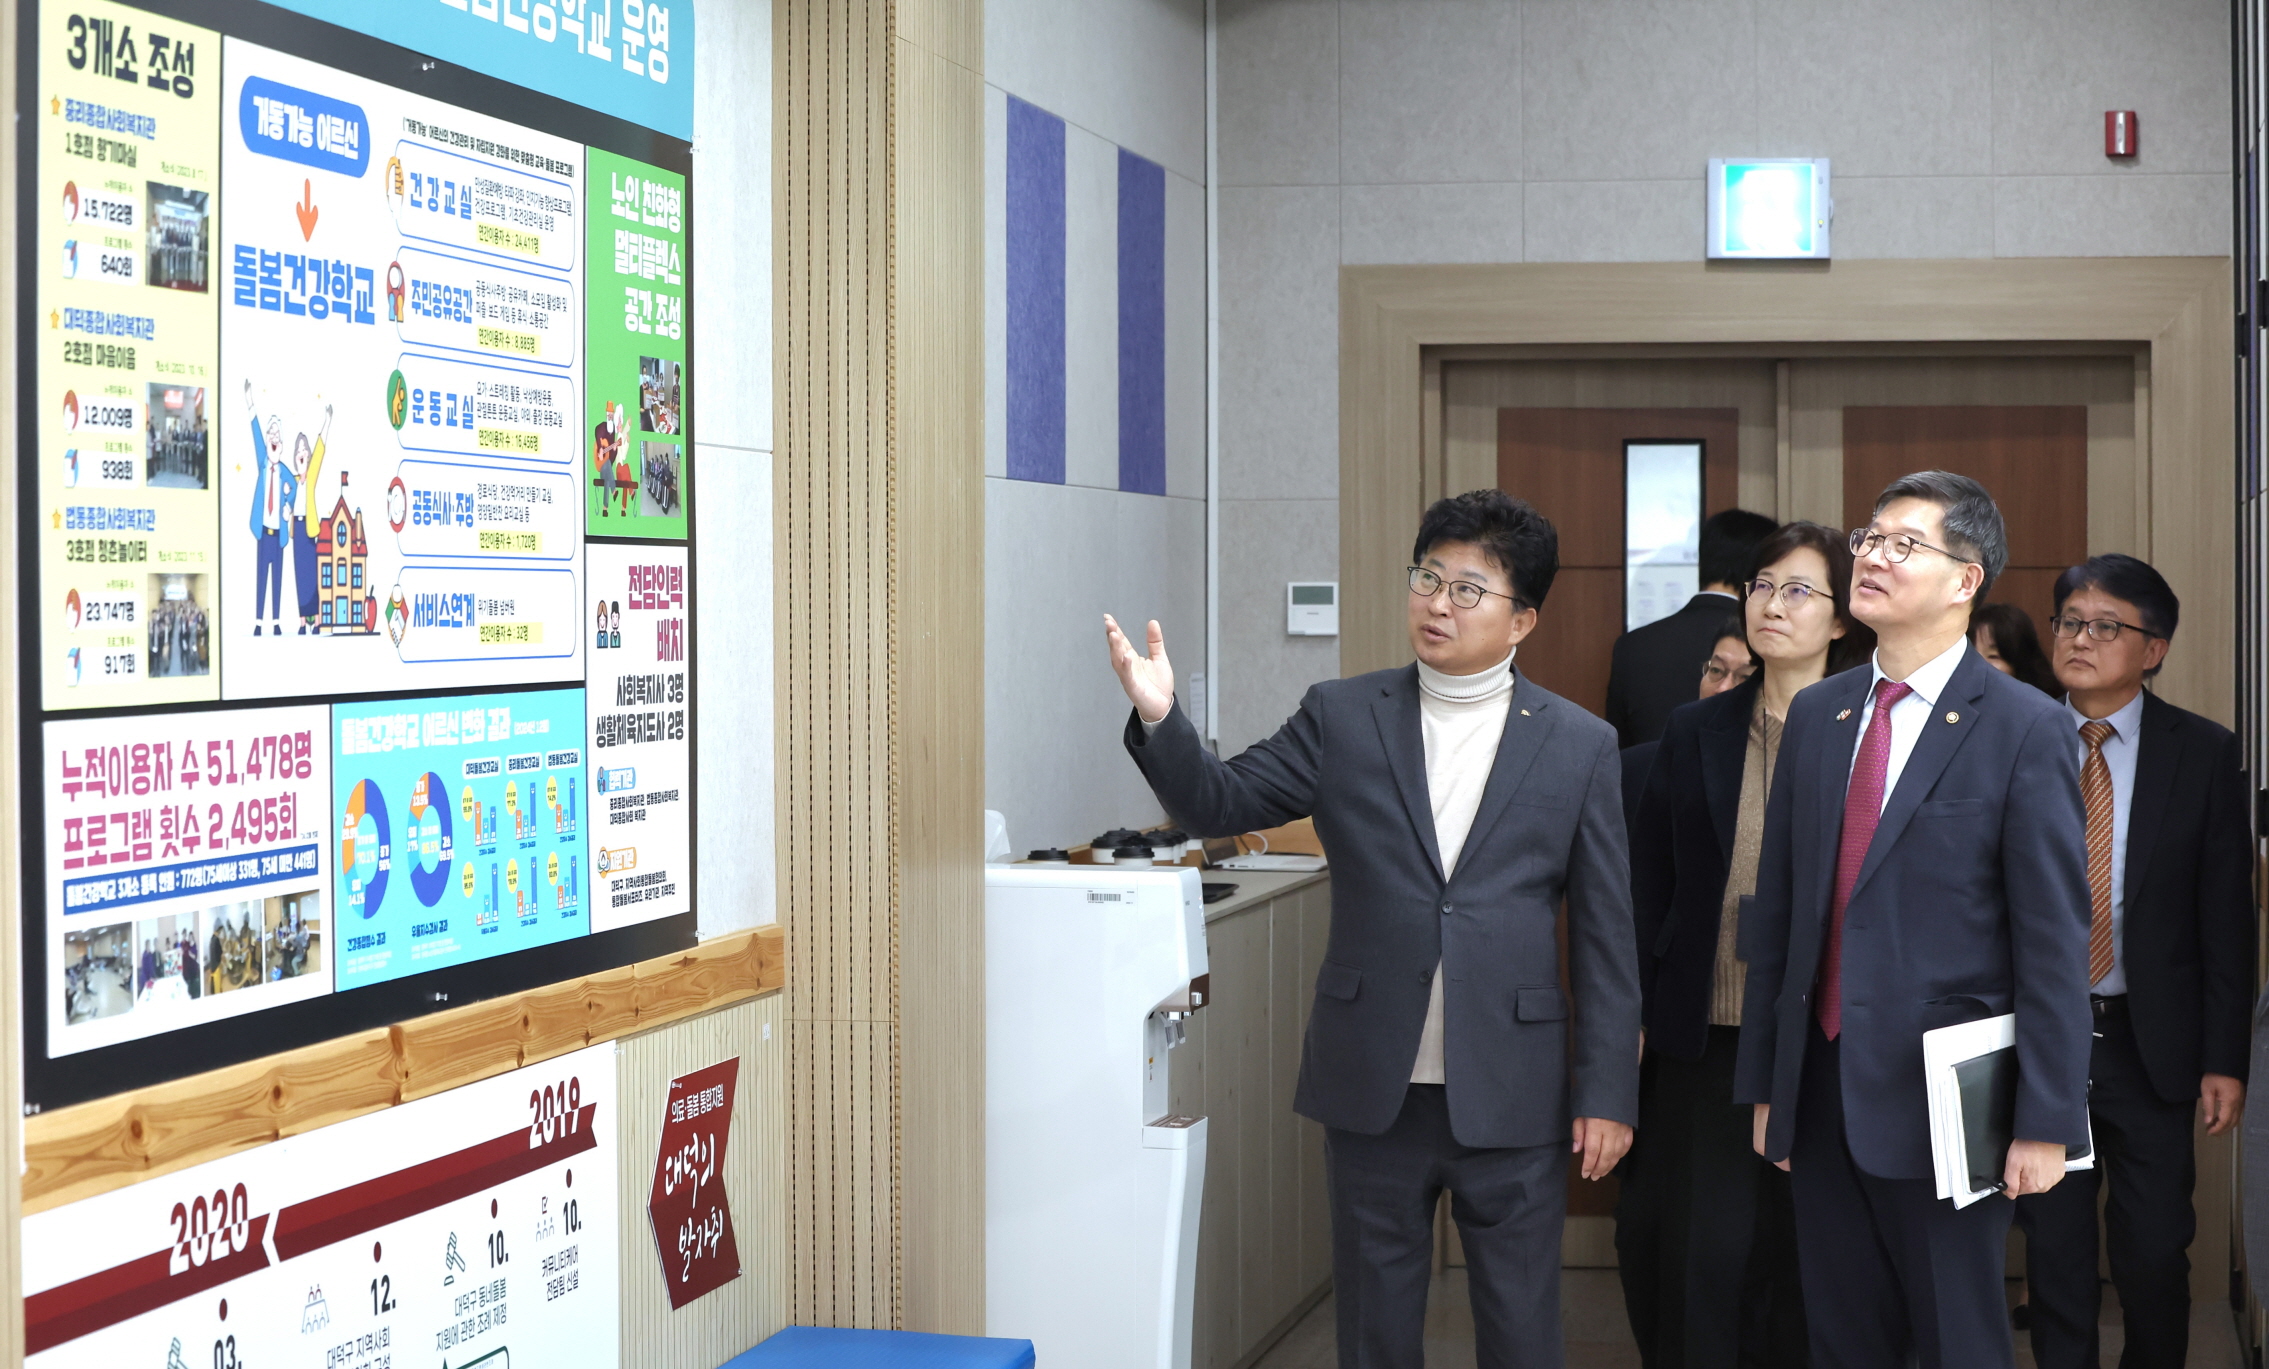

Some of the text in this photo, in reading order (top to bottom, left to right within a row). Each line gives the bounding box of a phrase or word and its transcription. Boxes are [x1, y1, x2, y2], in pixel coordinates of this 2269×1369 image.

[67, 14, 194, 99] 3개소 조성
[621, 0, 669, 84] 운영
[66, 98, 155, 140] 중리종합사회복지관
[253, 96, 359, 160] 거동가능 어르신
[66, 133, 93, 159] 1호점
[611, 171, 681, 234] 노인 친화형
[478, 225, 504, 247] 연간이용자
[505, 231, 511, 248] 수
[545, 214, 554, 232] 운영
[101, 254, 133, 277] 640회
[615, 228, 681, 286] 멀티플렉스
[234, 243, 375, 325] 돌봄건강학교
[411, 279, 472, 324] 주민공유공간
[64, 308, 155, 341] 대덕종합사회복지관
[624, 286, 681, 340] 공간 조성
[64, 342, 92, 365] 2호점
[97, 344, 136, 370] 마음이음
[478, 328, 504, 348] 연간이용자
[505, 333, 511, 349] 수
[544, 409, 562, 428] 운동교실
[478, 430, 504, 448] 연간이용자
[505, 432, 511, 449] 수
[102, 460, 133, 480] 938회
[66, 506, 155, 531] 법동종합사회복지관
[504, 506, 523, 522] 요리교실
[525, 506, 530, 522] 등
[67, 541, 94, 561] 3호점
[99, 541, 148, 562] 청춘놀이터
[480, 532, 505, 549] 연간이용자
[506, 534, 512, 549] 수
[628, 564, 683, 610] 전담인력
[413, 593, 475, 627] 서비스연계
[480, 625, 506, 642] 연간이용자
[507, 625, 512, 641] 수
[657, 617, 683, 662] 배치
[105, 654, 135, 674] 917회
[616, 672, 684, 706] 사회복지사 3명
[341, 713, 420, 755] 돌봄건강학교
[423, 710, 459, 748] 어르신
[488, 706, 511, 743] 결과
[596, 709, 684, 748] 생활체육지도사 2명
[62, 730, 312, 802] 누적이용자 수 51,478명
[63, 808, 152, 870] 프로그램
[159, 803, 201, 858] 횟수
[208, 791, 297, 850] 2,495회
[529, 1076, 580, 1150] 2019
[700, 1083, 724, 1115] 통합지원
[665, 1132, 715, 1209] 대덕의
[169, 1182, 249, 1276] 2020
[563, 1199, 582, 1235] 10.
[488, 1230, 509, 1268] 10.
[542, 1244, 578, 1278] 커뮤니티케어
[678, 1206, 723, 1283] 발자취
[370, 1274, 396, 1316] 12.
[455, 1277, 506, 1317] 대덕구 동네돌봄
[547, 1268, 578, 1302] 전담팀 신설
[436, 1302, 507, 1351] 지원에 관한 조례 제정
[327, 1325, 390, 1369] 대덕구 지역사회
